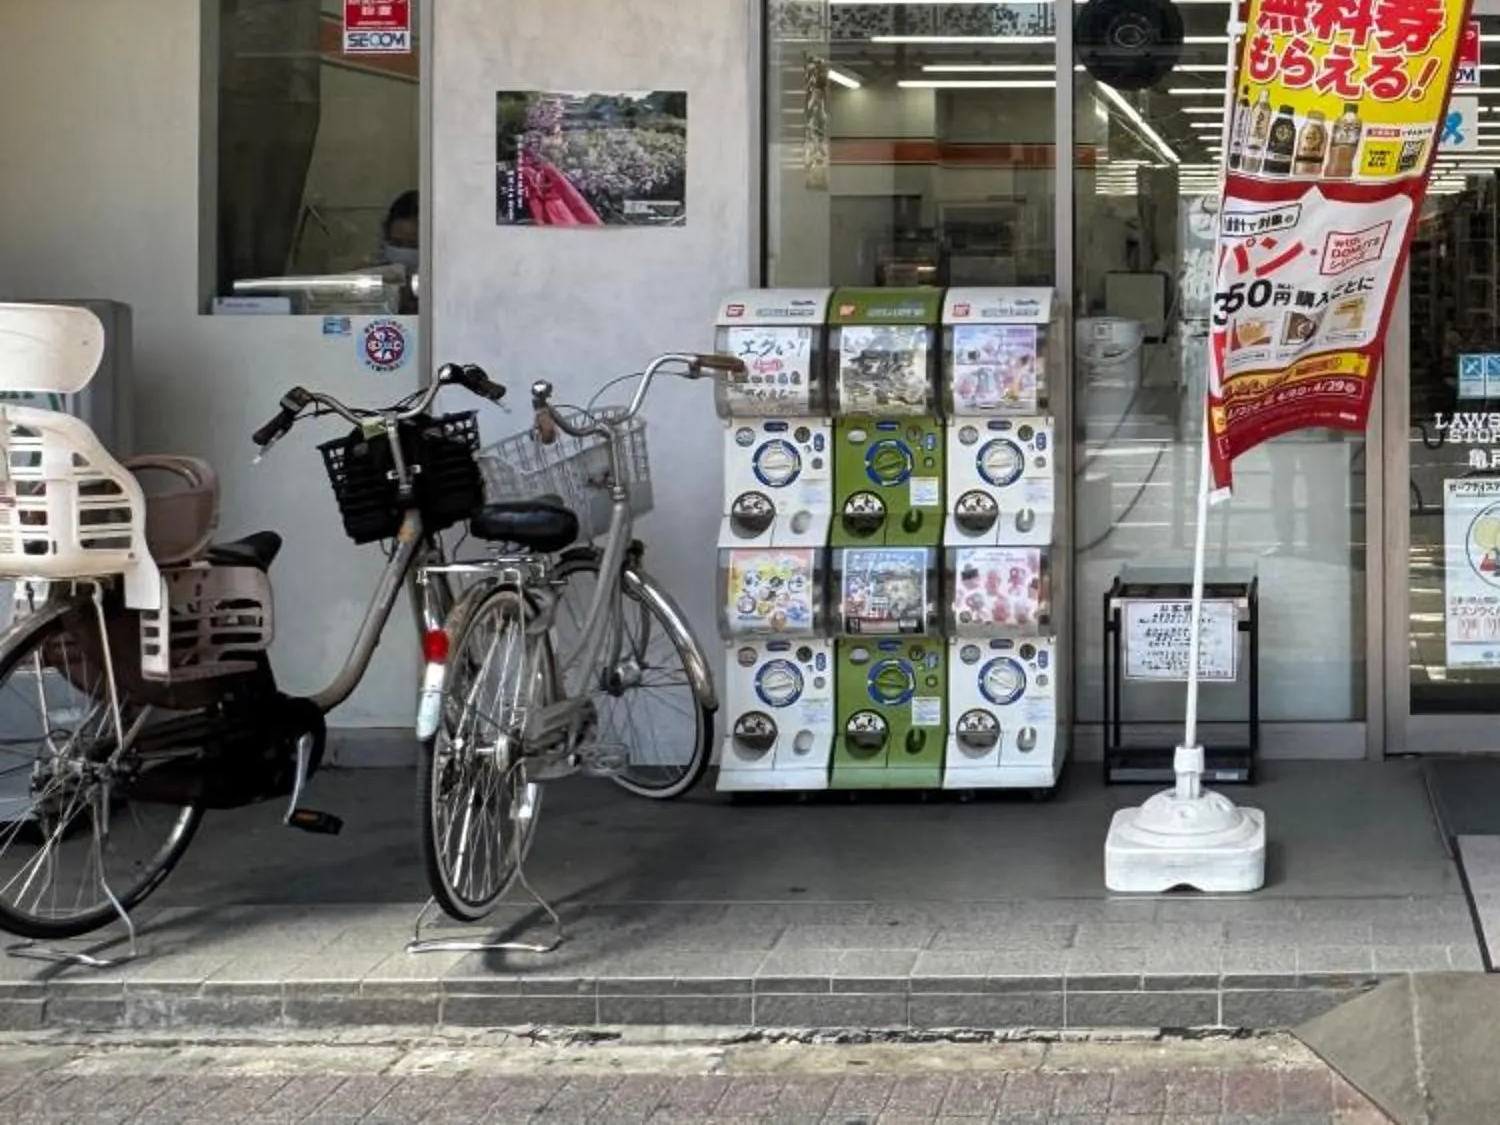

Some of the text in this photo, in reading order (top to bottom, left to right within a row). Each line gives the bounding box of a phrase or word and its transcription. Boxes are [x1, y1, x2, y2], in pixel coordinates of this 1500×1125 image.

[347, 32, 405, 47] SECOM
[1249, 34, 1441, 101] もらえる!
